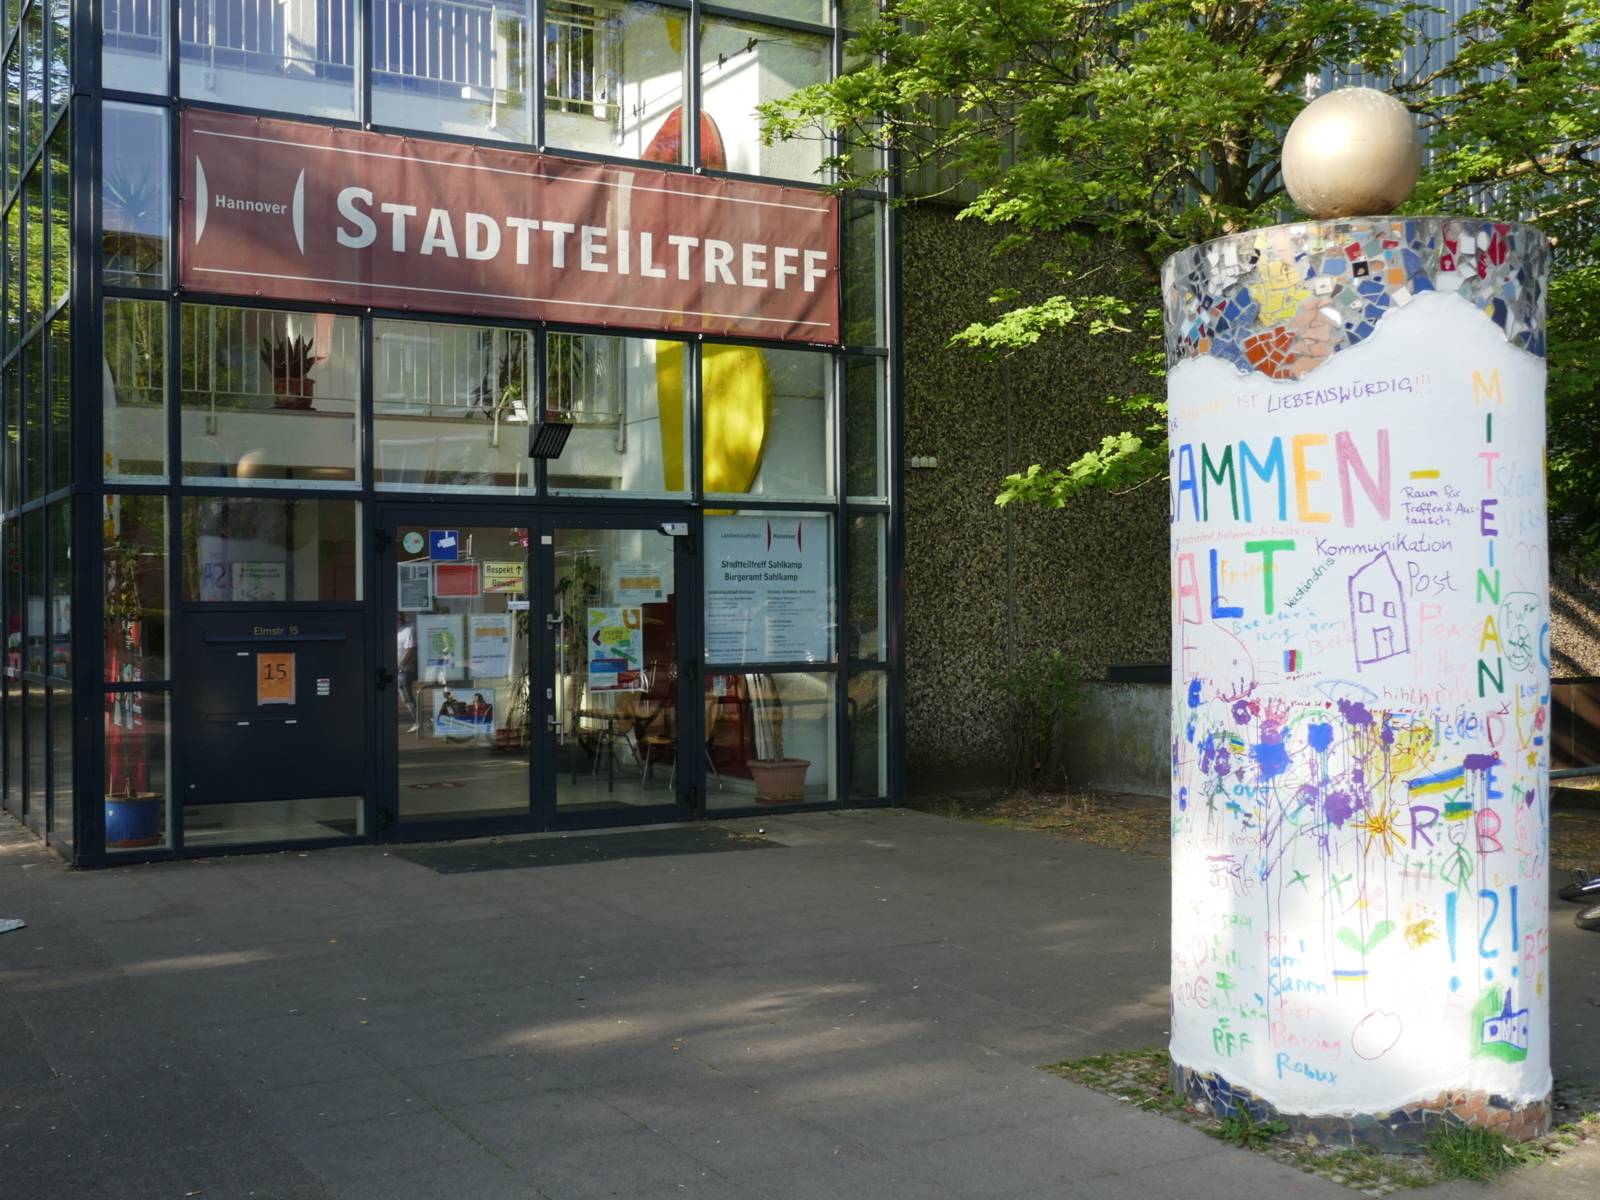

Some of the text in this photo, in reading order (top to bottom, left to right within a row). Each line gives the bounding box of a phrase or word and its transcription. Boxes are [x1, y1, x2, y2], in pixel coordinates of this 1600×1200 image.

[215, 194, 287, 215] Hannover
[336, 187, 827, 292] STADTTEILTREFF
[1401, 484, 1461, 499] Raum für
[1405, 515, 1452, 526] tausch
[1315, 533, 1454, 556] Kommunikation
[487, 565, 513, 575] Respekt
[721, 560, 803, 569] Stadtteiltreff Sahlkamp
[763, 573, 798, 582] Sahlkamp
[1408, 560, 1458, 597] Post
[289, 626, 299, 635] 15
[263, 664, 288, 680] 15
